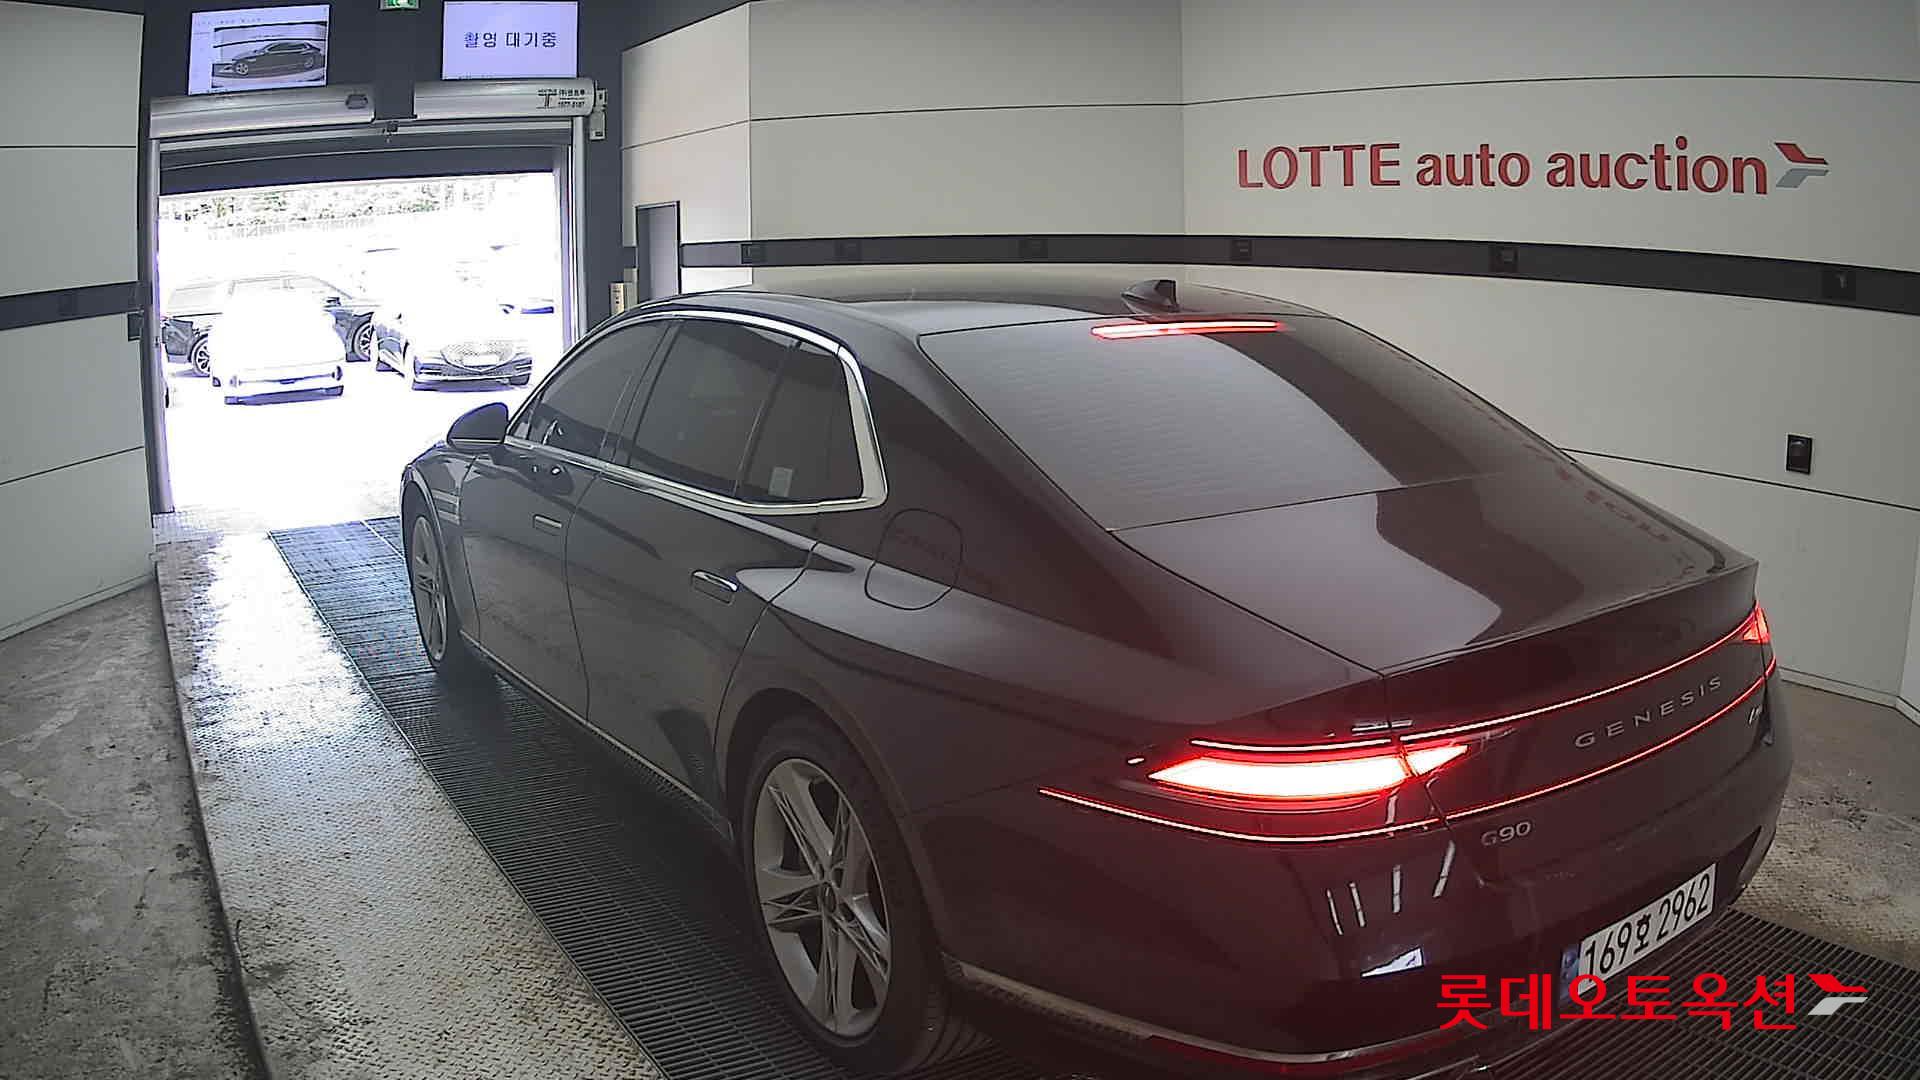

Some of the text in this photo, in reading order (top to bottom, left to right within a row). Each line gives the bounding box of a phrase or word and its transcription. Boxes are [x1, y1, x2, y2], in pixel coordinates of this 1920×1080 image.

[464, 32, 557, 48] 촬영 대기중
[1238, 136, 1767, 195] LOTTE auto auction
[1574, 676, 1721, 748] GENESIS
[1480, 821, 1532, 846] G90
[1656, 873, 1710, 941] 2962
